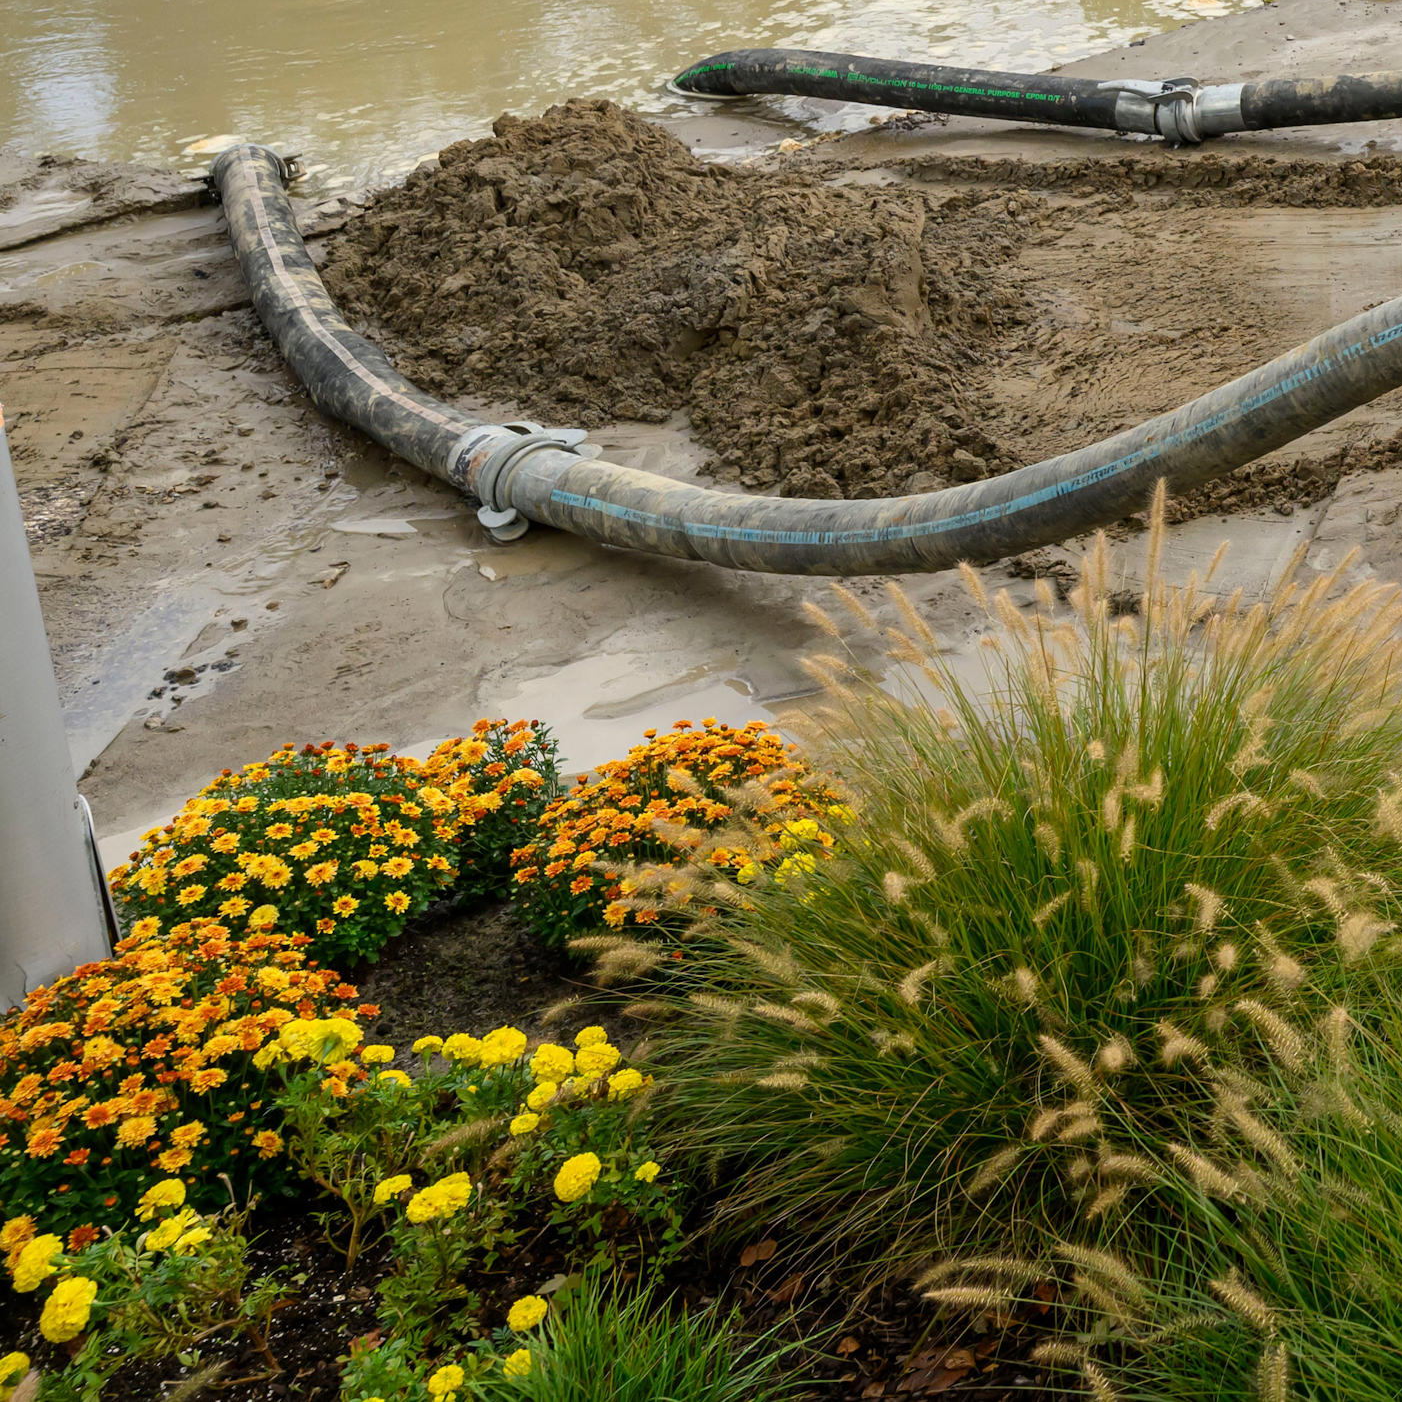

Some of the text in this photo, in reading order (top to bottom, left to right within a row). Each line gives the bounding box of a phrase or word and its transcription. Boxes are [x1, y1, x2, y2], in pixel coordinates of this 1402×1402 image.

[954, 85, 986, 96] GENERAL
[988, 89, 1021, 98] PURPOSE
[1026, 91, 1047, 101] EPDM
